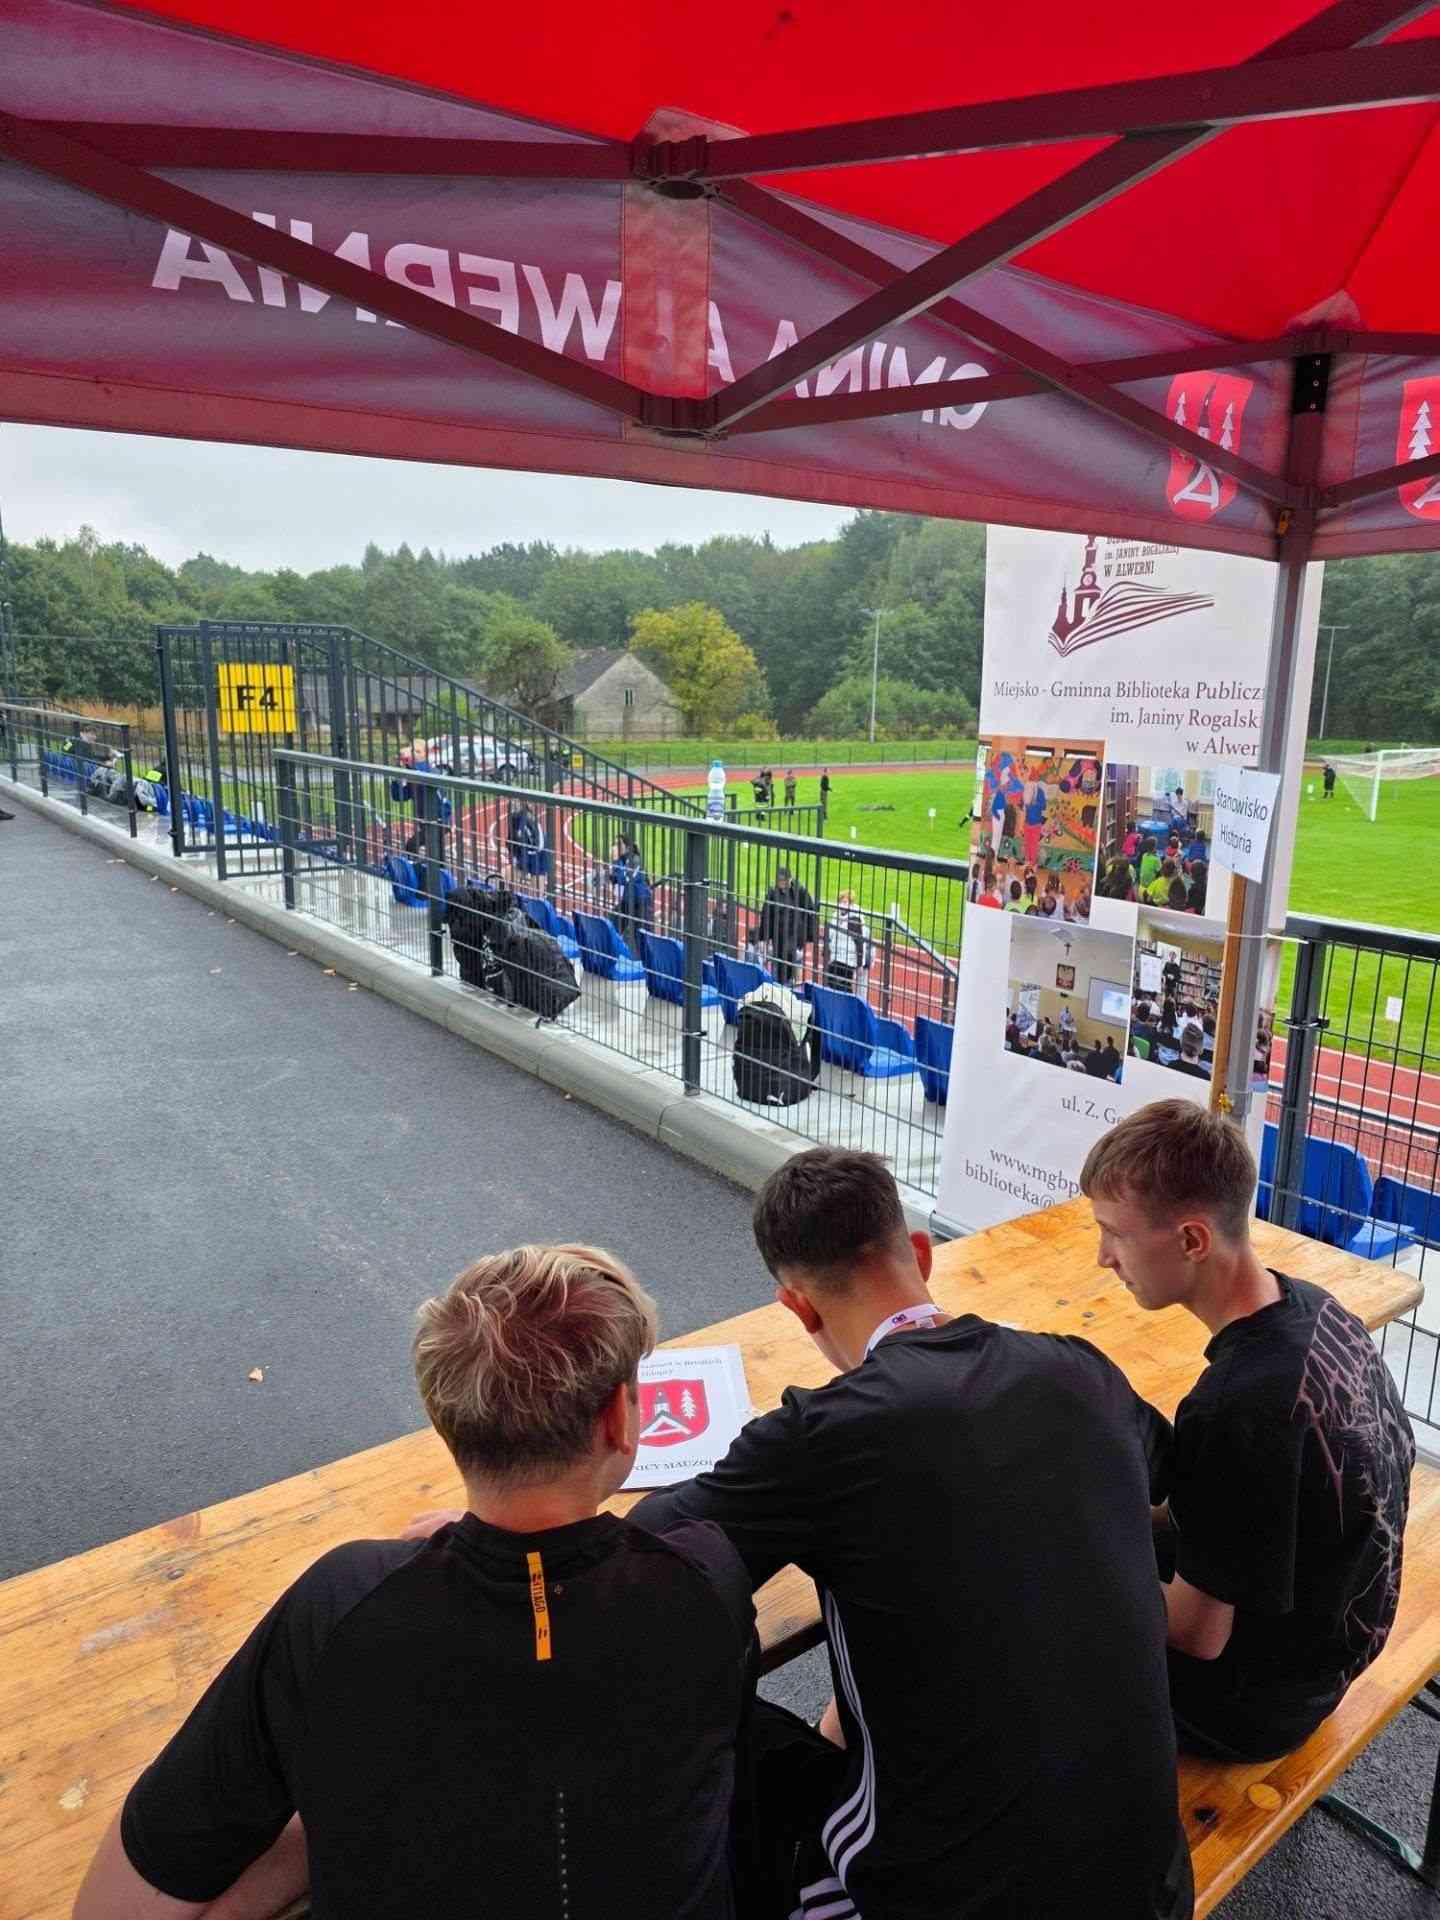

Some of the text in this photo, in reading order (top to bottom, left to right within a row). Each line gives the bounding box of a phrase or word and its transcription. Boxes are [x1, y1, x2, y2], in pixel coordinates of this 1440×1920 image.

[1104, 560, 1155, 577] W ALWERNI
[236, 685, 279, 711] F4
[993, 681, 1039, 701] Miejsko
[1050, 680, 1111, 699] Gminna
[1116, 681, 1190, 700] Biblioteka
[1195, 681, 1265, 701] Publicz
[1110, 706, 1261, 732] im. Janiny Rogalsk
[1185, 741, 1202, 753] w
[1216, 787, 1268, 821] Stanowisko
[1219, 823, 1252, 854] Historia
[1061, 1095, 1081, 1113] ul.
[1084, 1100, 1099, 1119] Z.
